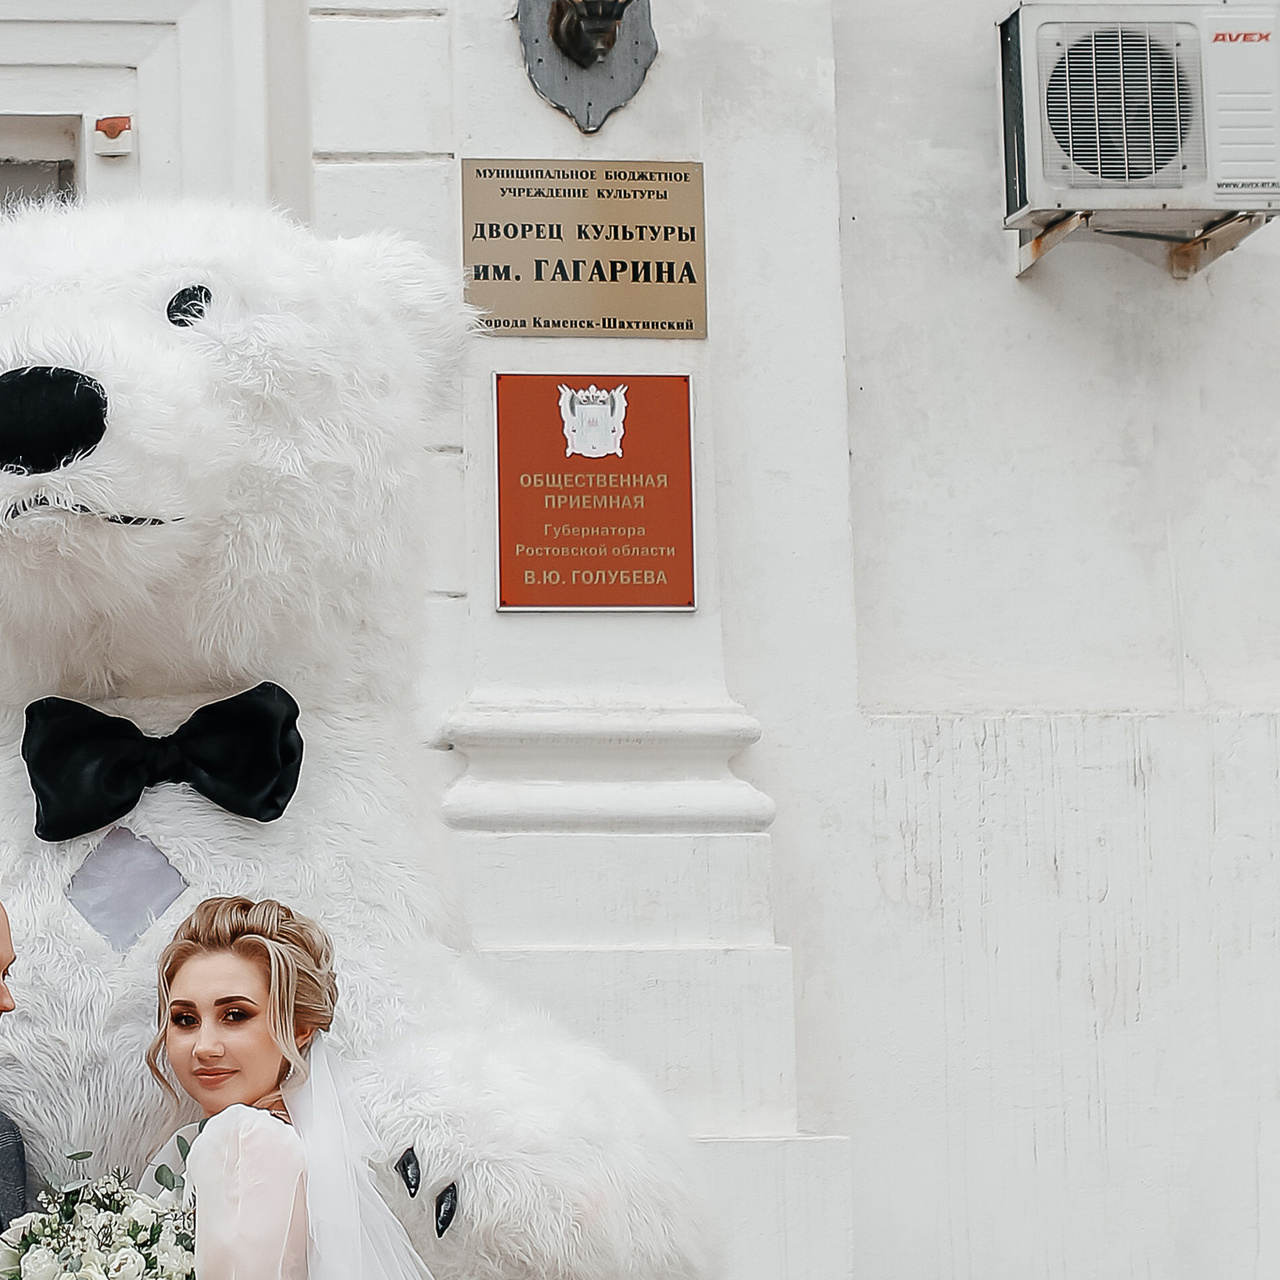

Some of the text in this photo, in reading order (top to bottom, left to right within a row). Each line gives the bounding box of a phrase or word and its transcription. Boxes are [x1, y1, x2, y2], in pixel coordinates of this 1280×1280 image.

[1211, 31, 1272, 44] AVEX
[475, 168, 691, 183] МУНИЦИПАЛЬНОЕ БЮДЖЕТНОЕ
[499, 186, 668, 200] УЧРЕЖДЕНИЕ КУЛЬТУРЫ
[472, 222, 697, 242] ДВОРЕЦ КУЛЬТУРЫ
[473, 259, 698, 284] им. ГАГАРИНА
[533, 316, 694, 331] Каменск-Шахтинский
[519, 473, 668, 490] ОБЩЕСТВЕННАЯ
[544, 495, 645, 509] ПРИЕМНАЯ
[544, 524, 646, 539] Губернатора
[515, 544, 676, 557] Ростовской области
[524, 570, 668, 585] В.Ю. ГОЛУБЕВА
